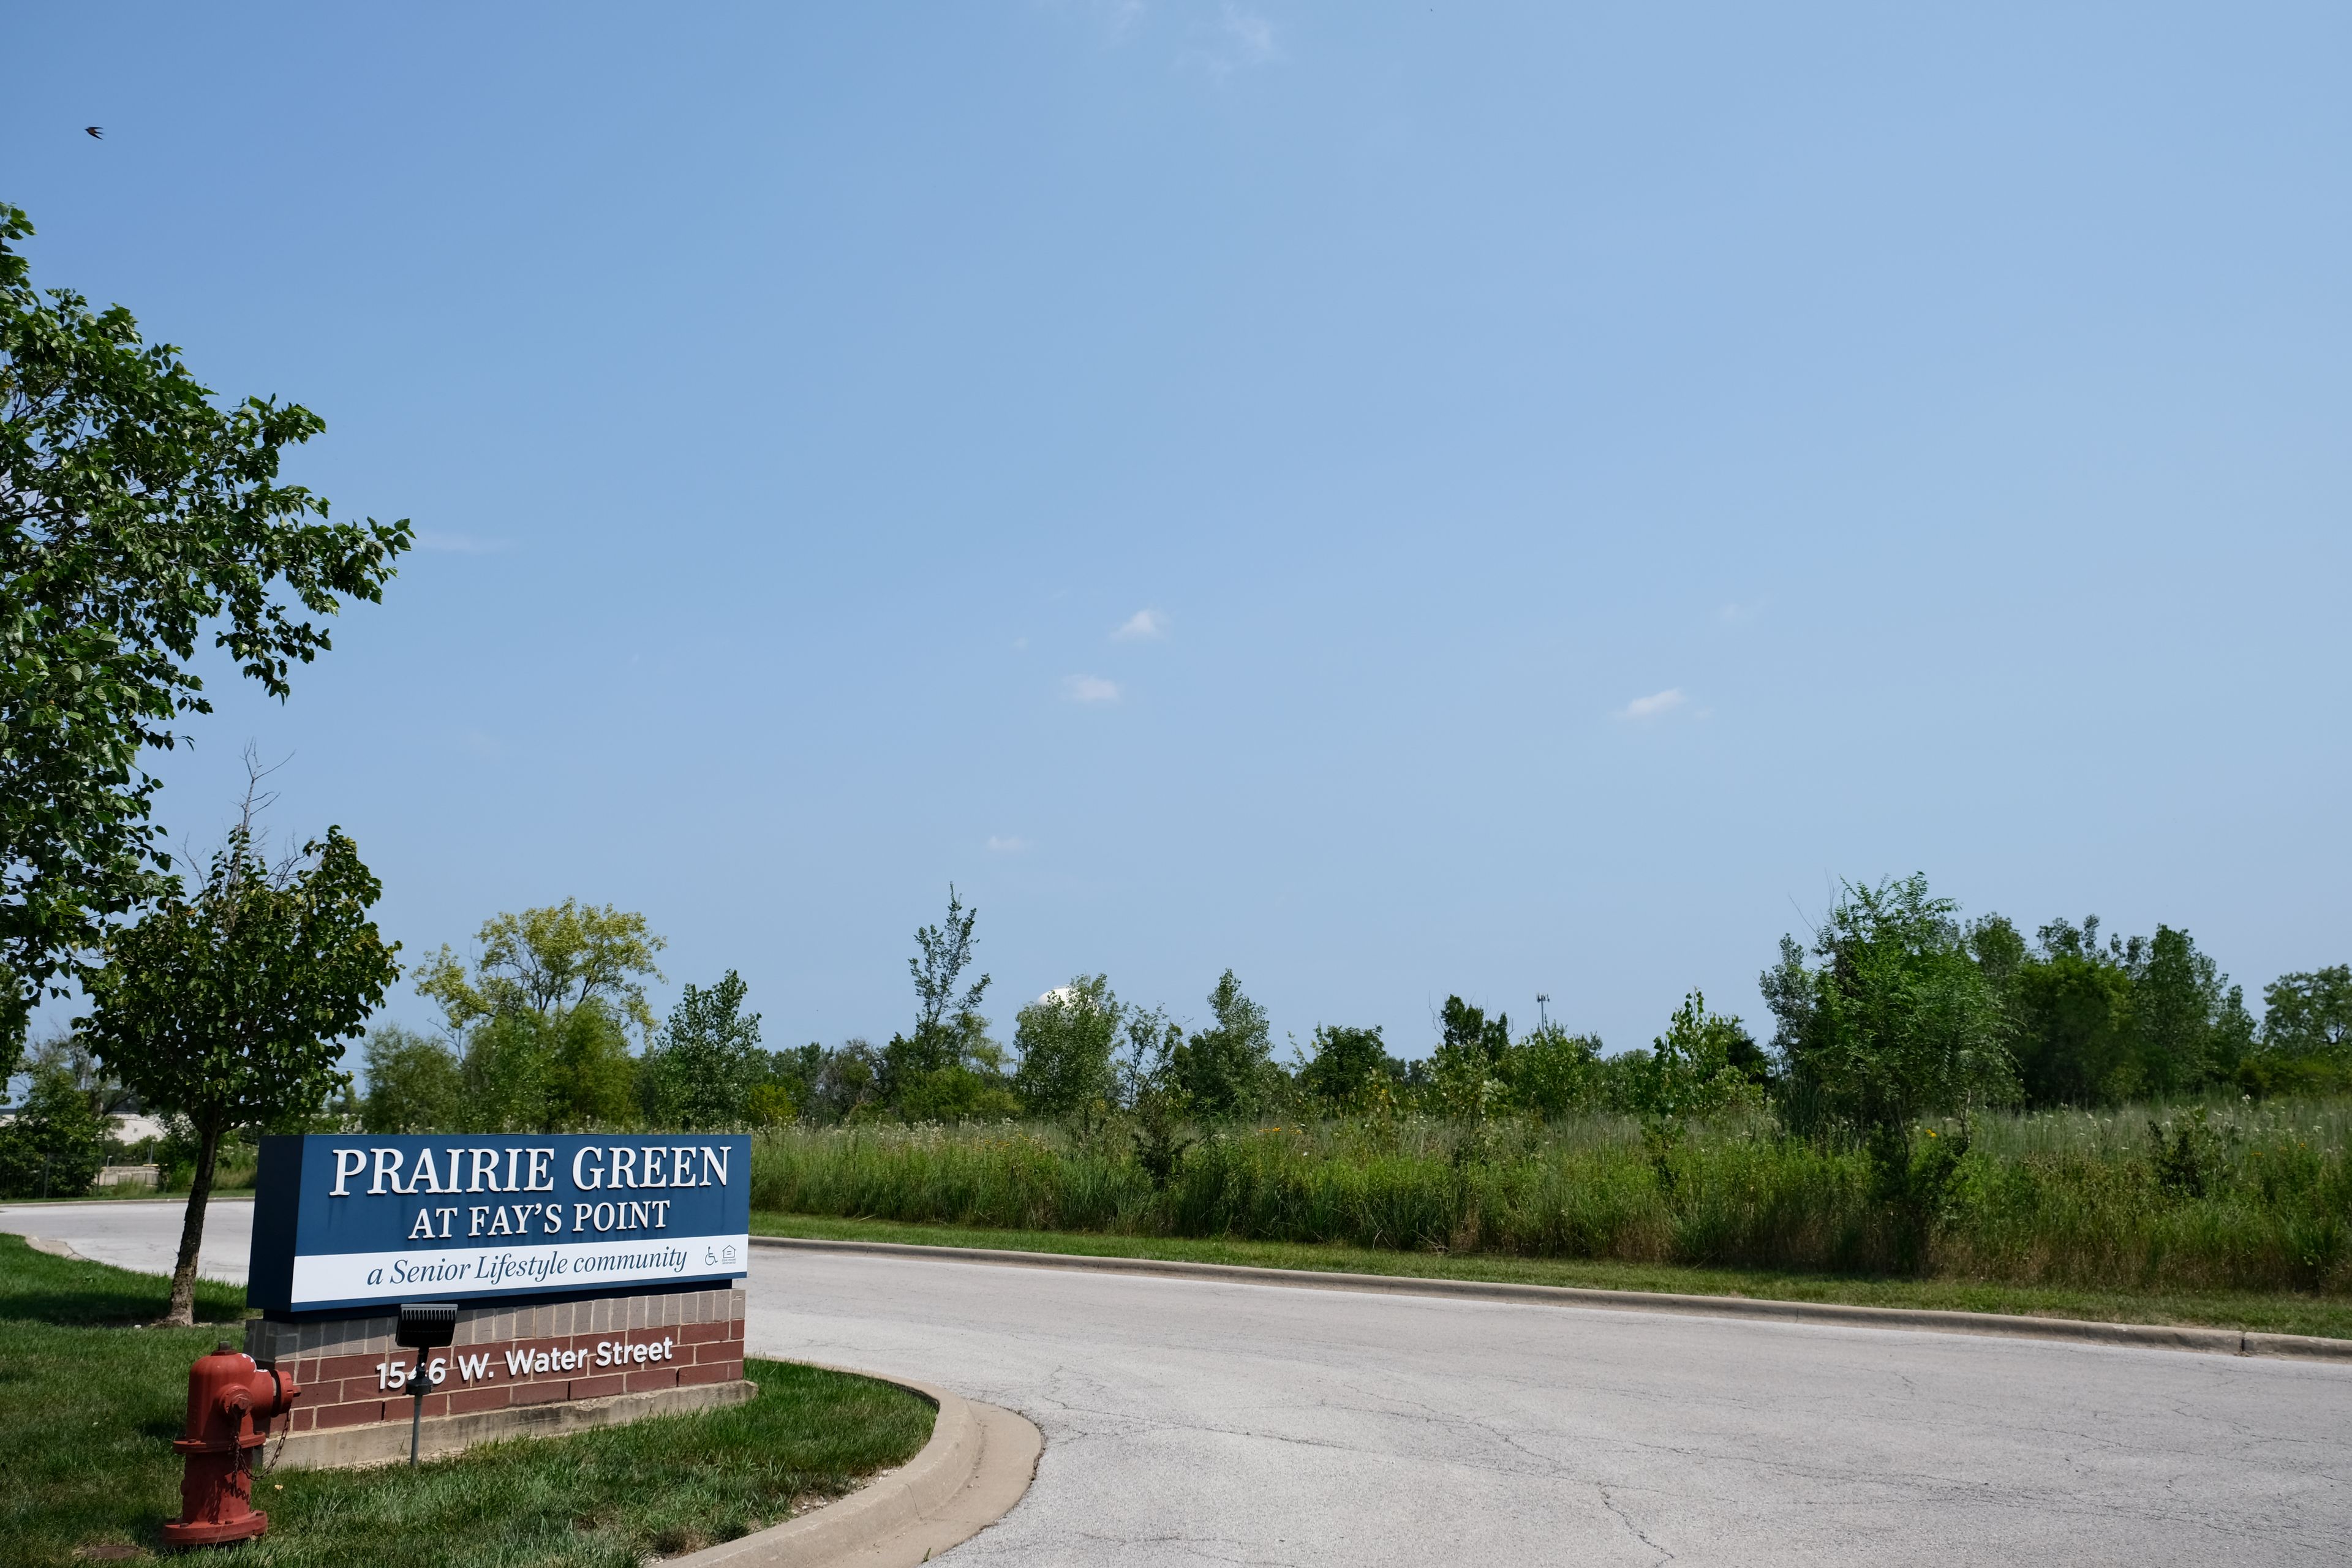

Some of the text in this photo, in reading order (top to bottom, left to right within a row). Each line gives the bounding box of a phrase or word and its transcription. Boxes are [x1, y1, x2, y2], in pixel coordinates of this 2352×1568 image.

[330, 1147, 731, 1195] PRAIRIE GREEN
[409, 1200, 669, 1238] AT FAY’S POINT
[368, 1246, 687, 1285] a Senior Lifestyle community
[459, 1354, 493, 1379] W.
[506, 1348, 587, 1374] Water
[596, 1337, 672, 1365] Street
